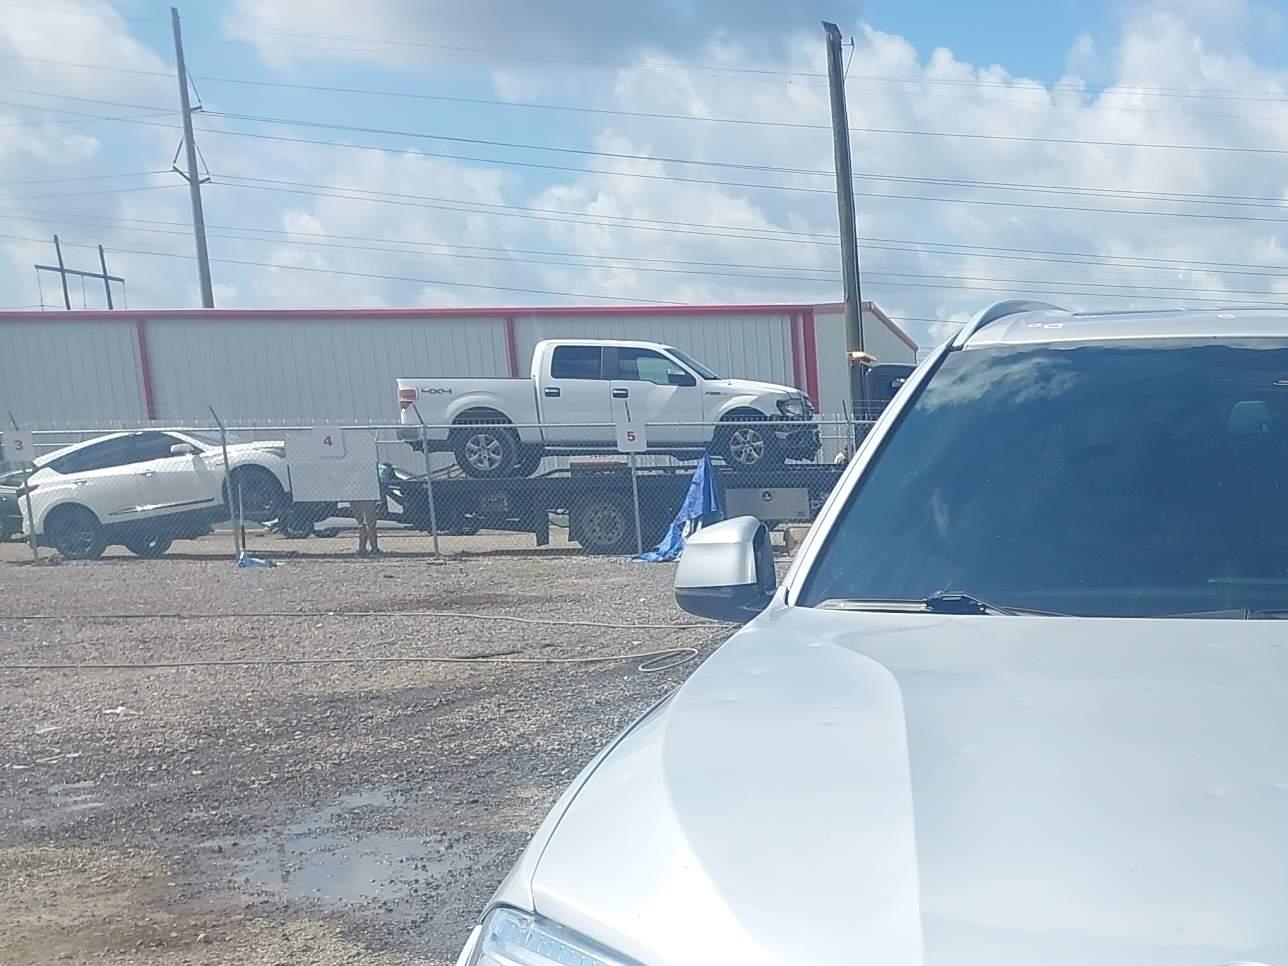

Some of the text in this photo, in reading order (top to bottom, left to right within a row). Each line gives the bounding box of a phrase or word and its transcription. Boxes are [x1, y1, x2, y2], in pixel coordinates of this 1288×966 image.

[323, 435, 333, 447] 4
[627, 431, 636, 442] 5
[14, 439, 24, 451] 3
